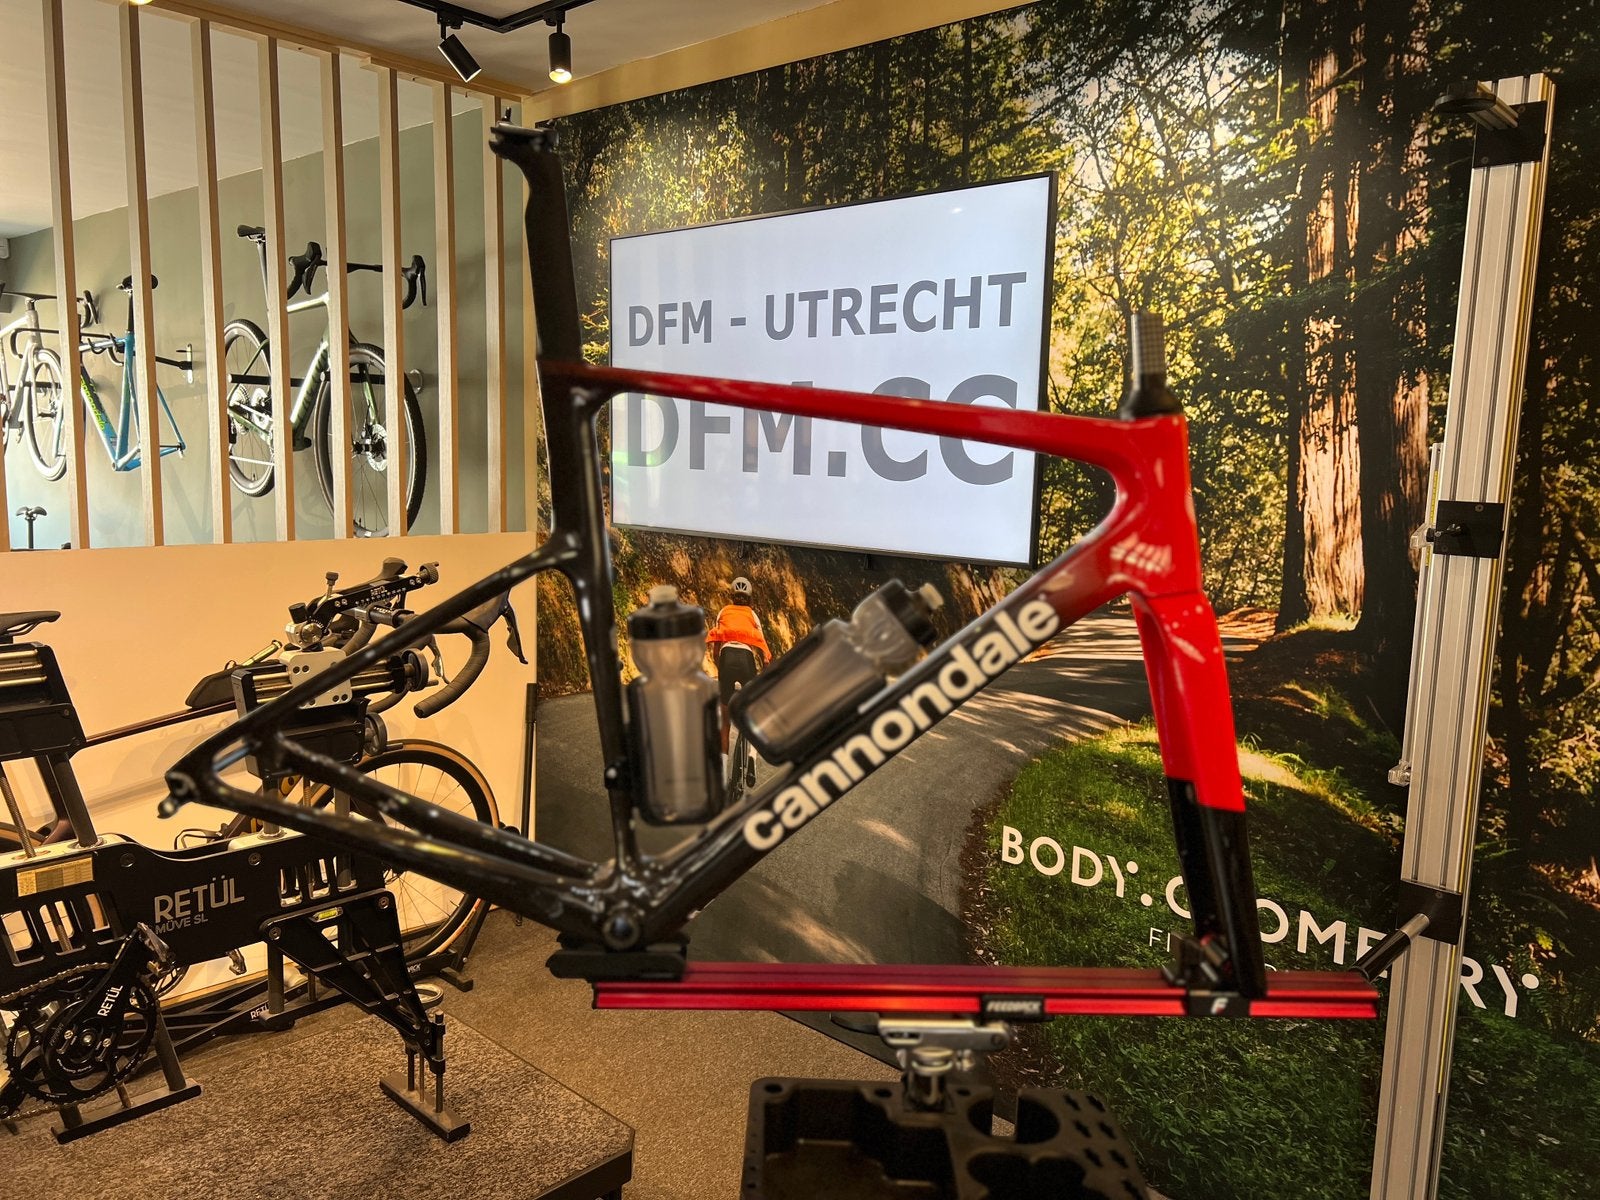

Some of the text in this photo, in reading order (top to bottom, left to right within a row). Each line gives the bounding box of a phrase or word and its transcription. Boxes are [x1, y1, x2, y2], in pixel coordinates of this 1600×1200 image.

[628, 299, 713, 347] DFM
[765, 272, 1028, 341] UTRECHT
[627, 374, 1018, 486] DFM.CC
[742, 599, 1061, 852] cannondale
[154, 874, 245, 924] RETÜL
[155, 912, 209, 935] MÜVE SL
